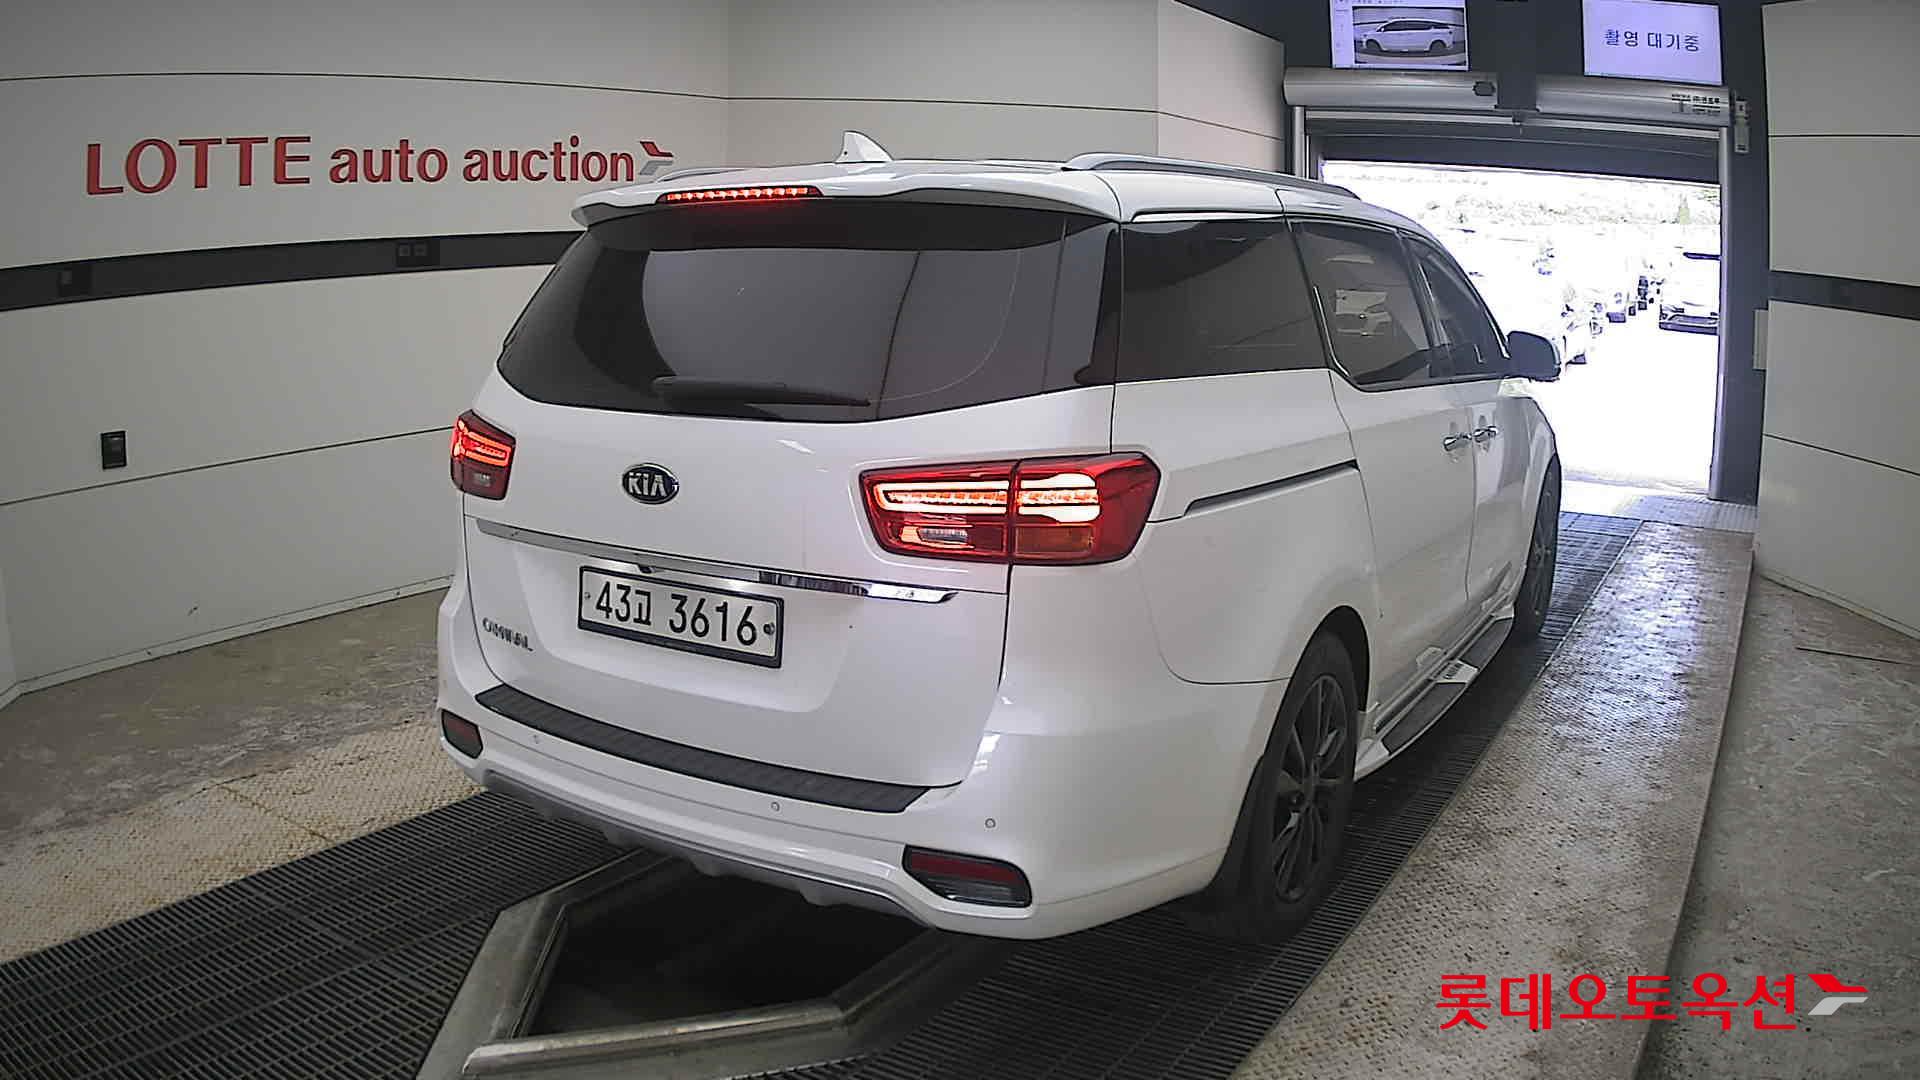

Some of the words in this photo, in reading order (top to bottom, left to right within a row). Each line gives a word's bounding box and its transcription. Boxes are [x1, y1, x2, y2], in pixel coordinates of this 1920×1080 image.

[1603, 28, 1639, 48] 촬영
[1646, 31, 1700, 53] 대기중
[85, 135, 312, 196] LOTTE
[328, 139, 449, 184] auto
[462, 135, 635, 183] auction
[628, 471, 668, 497] KIA
[595, 581, 652, 626] 43고
[668, 592, 758, 646] 3616
